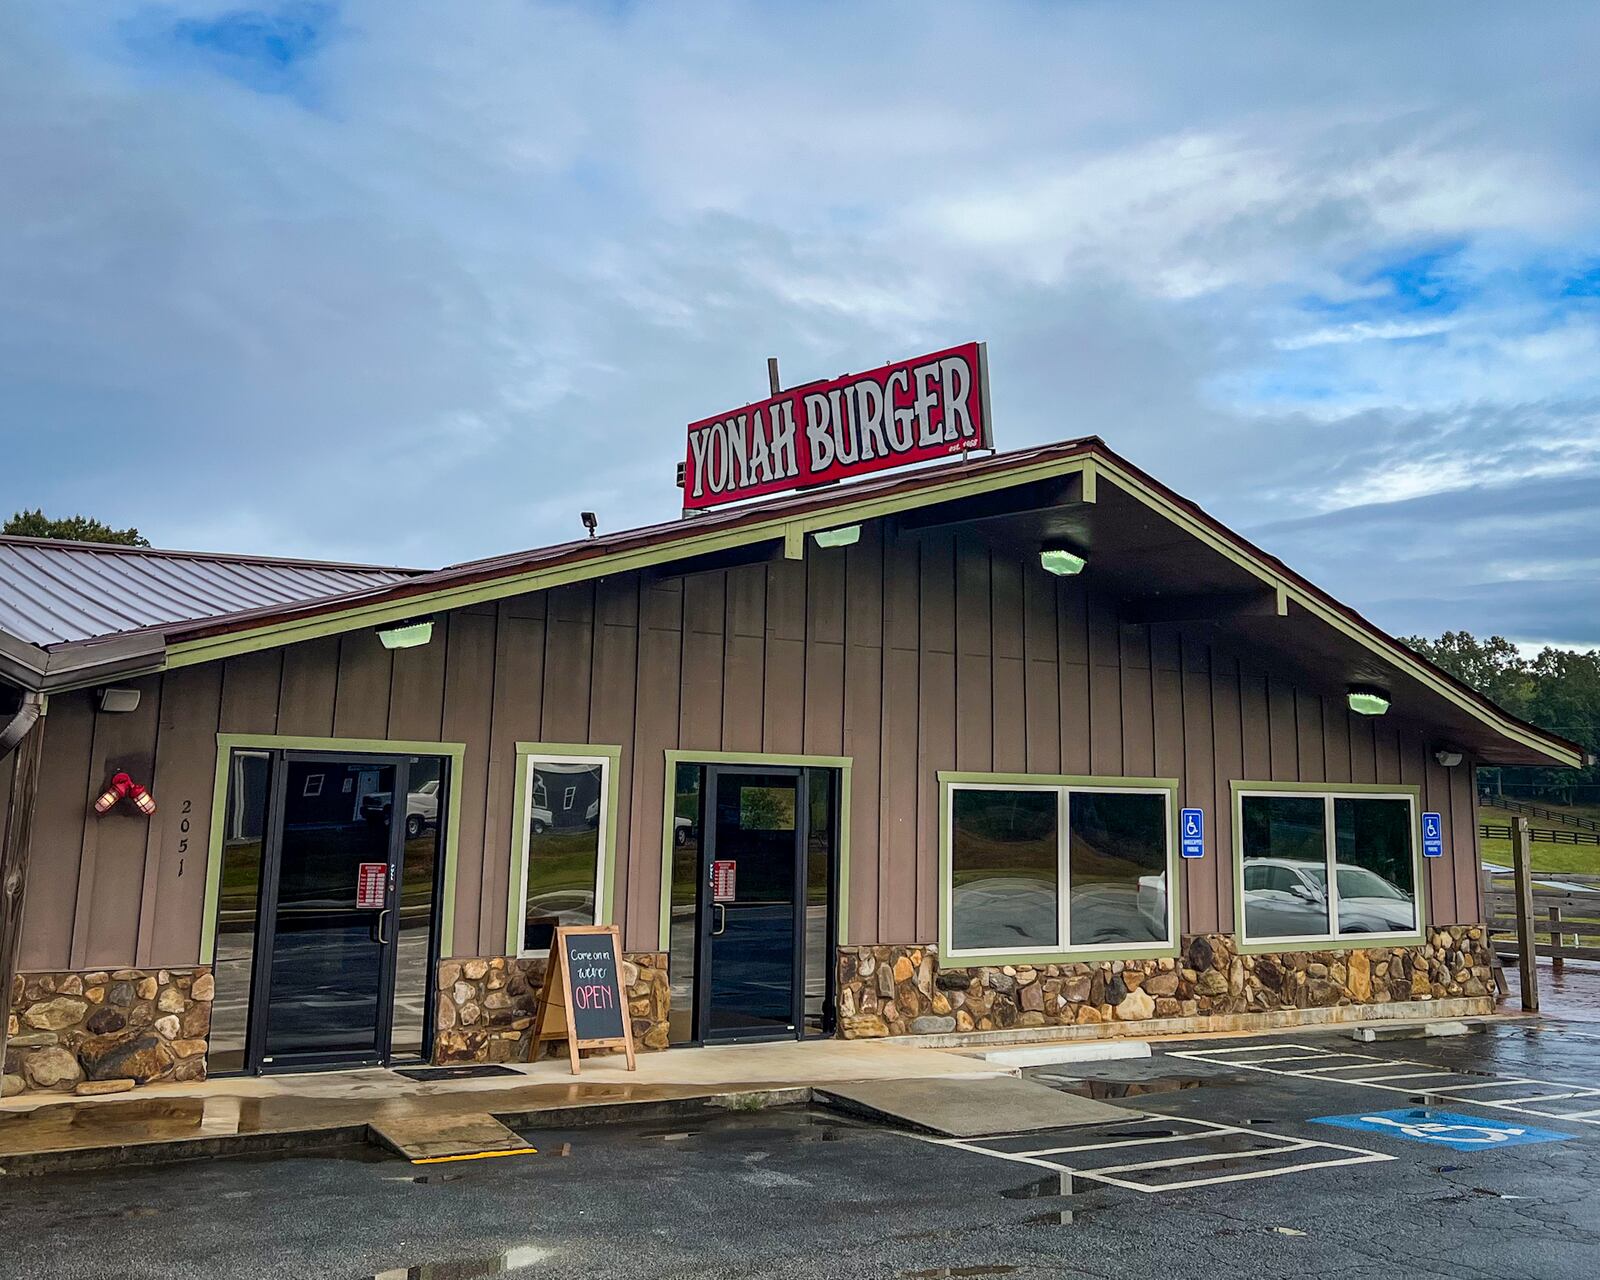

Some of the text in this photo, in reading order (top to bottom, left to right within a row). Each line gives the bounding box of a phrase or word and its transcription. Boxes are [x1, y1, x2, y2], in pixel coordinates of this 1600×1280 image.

[689, 355, 975, 498] YONAH BURGER
[178, 800, 192, 877] 2051
[570, 949, 592, 961] Come
[575, 985, 613, 1010] OPEN
